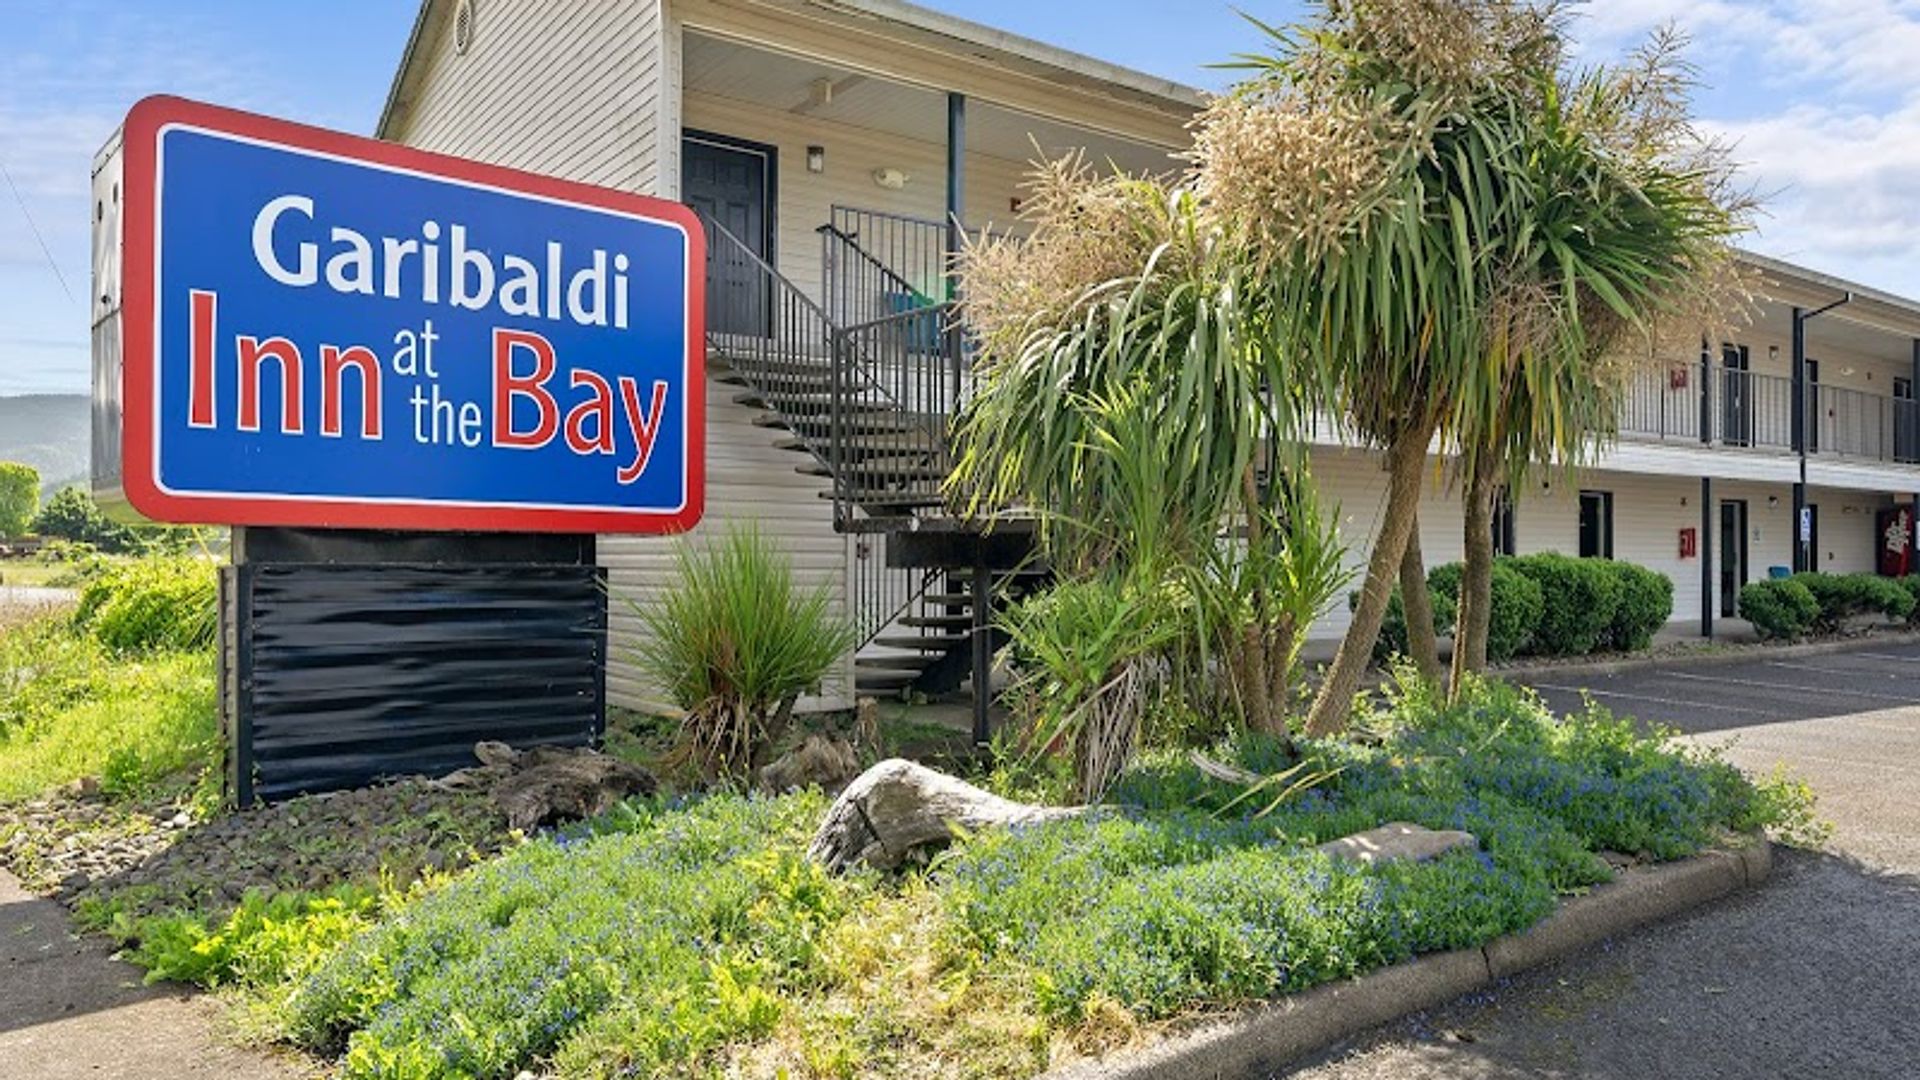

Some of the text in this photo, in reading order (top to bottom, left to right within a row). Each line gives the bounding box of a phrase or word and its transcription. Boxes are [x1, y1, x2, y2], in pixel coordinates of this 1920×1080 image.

[252, 194, 630, 329] Garibaldi
[187, 288, 669, 485] Inn at the Bay
